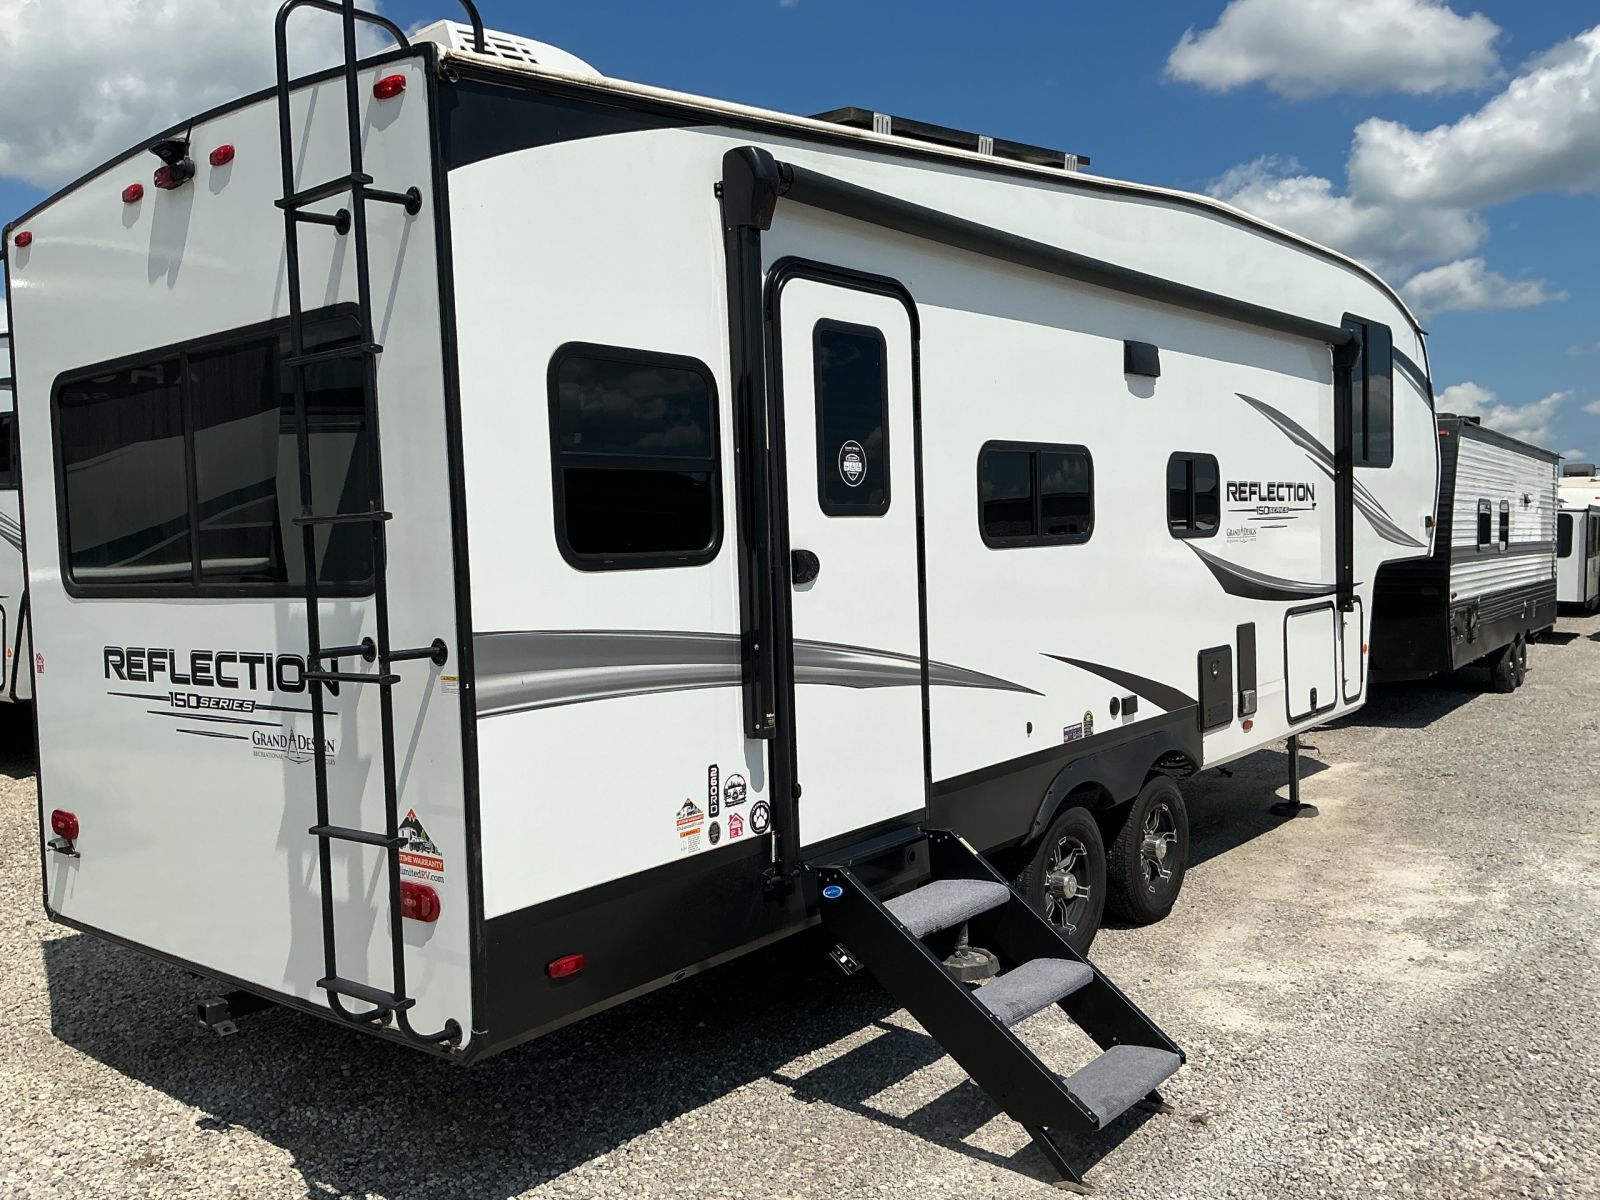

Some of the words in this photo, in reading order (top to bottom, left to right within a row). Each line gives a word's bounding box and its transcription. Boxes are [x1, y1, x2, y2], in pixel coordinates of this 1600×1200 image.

[1226, 481, 1315, 502] REFLECTION
[1226, 527, 1241, 536] GRAND
[1243, 527, 1257, 536] DESIGN
[104, 646, 340, 697] REFLECTION
[252, 730, 288, 748] GRAND
[710, 767, 718, 814] 260RD
[413, 857, 443, 869] WARRANTY
[400, 867, 445, 883] limitedRV.com
